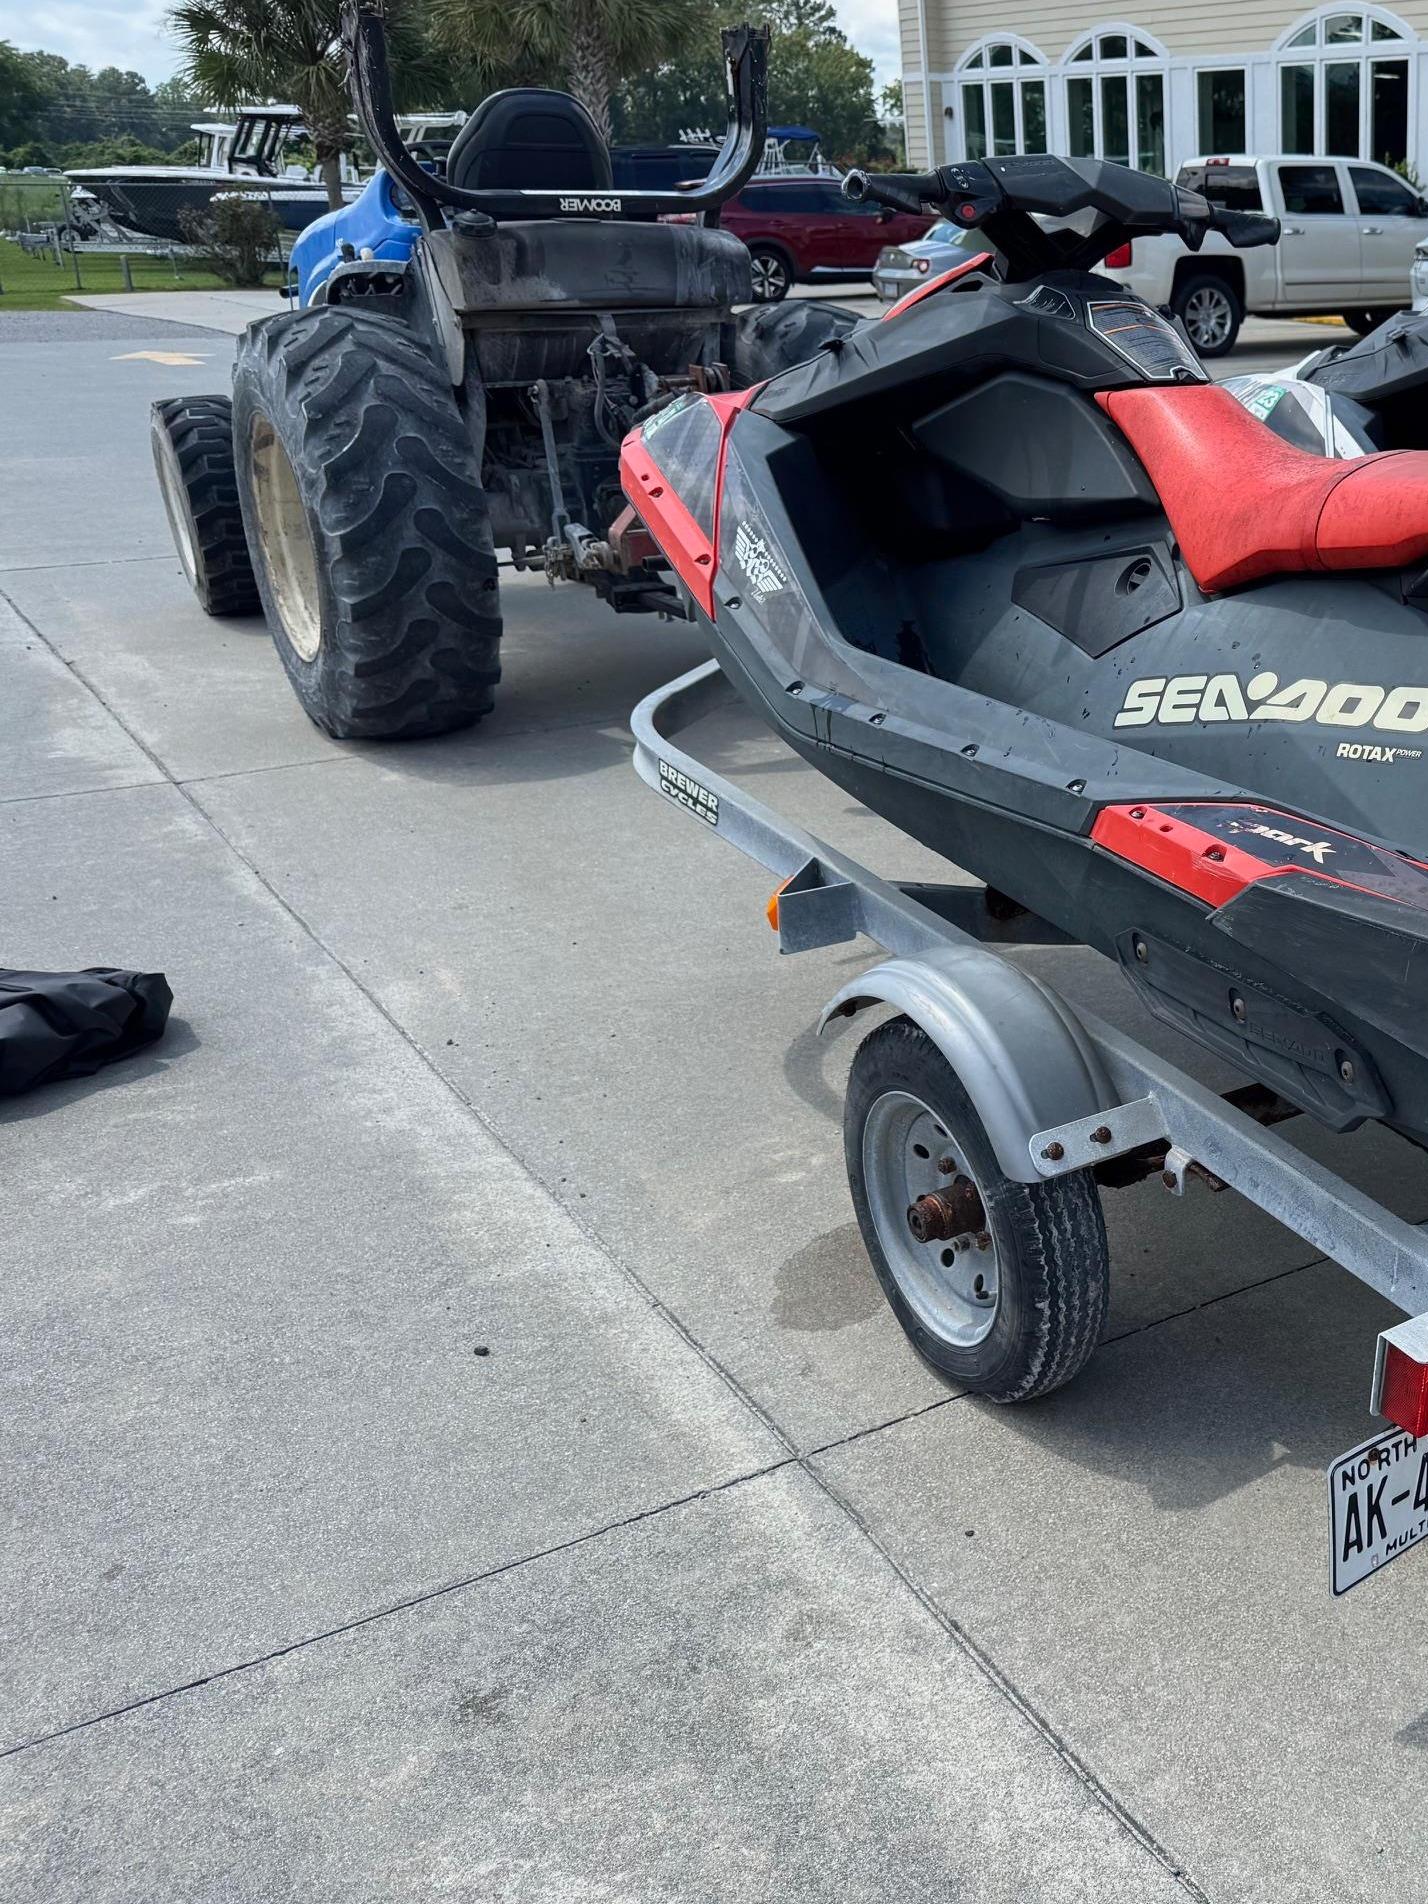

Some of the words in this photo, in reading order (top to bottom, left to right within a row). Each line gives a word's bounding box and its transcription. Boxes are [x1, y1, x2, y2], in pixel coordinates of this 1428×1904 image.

[559, 198, 621, 212] BOOMER
[1336, 742, 1397, 763] ROTAX
[1396, 748, 1423, 759] POWER
[659, 760, 719, 813] BREWER
[661, 778, 719, 824] CYCLES
[1342, 1436, 1417, 1492] NORTH
